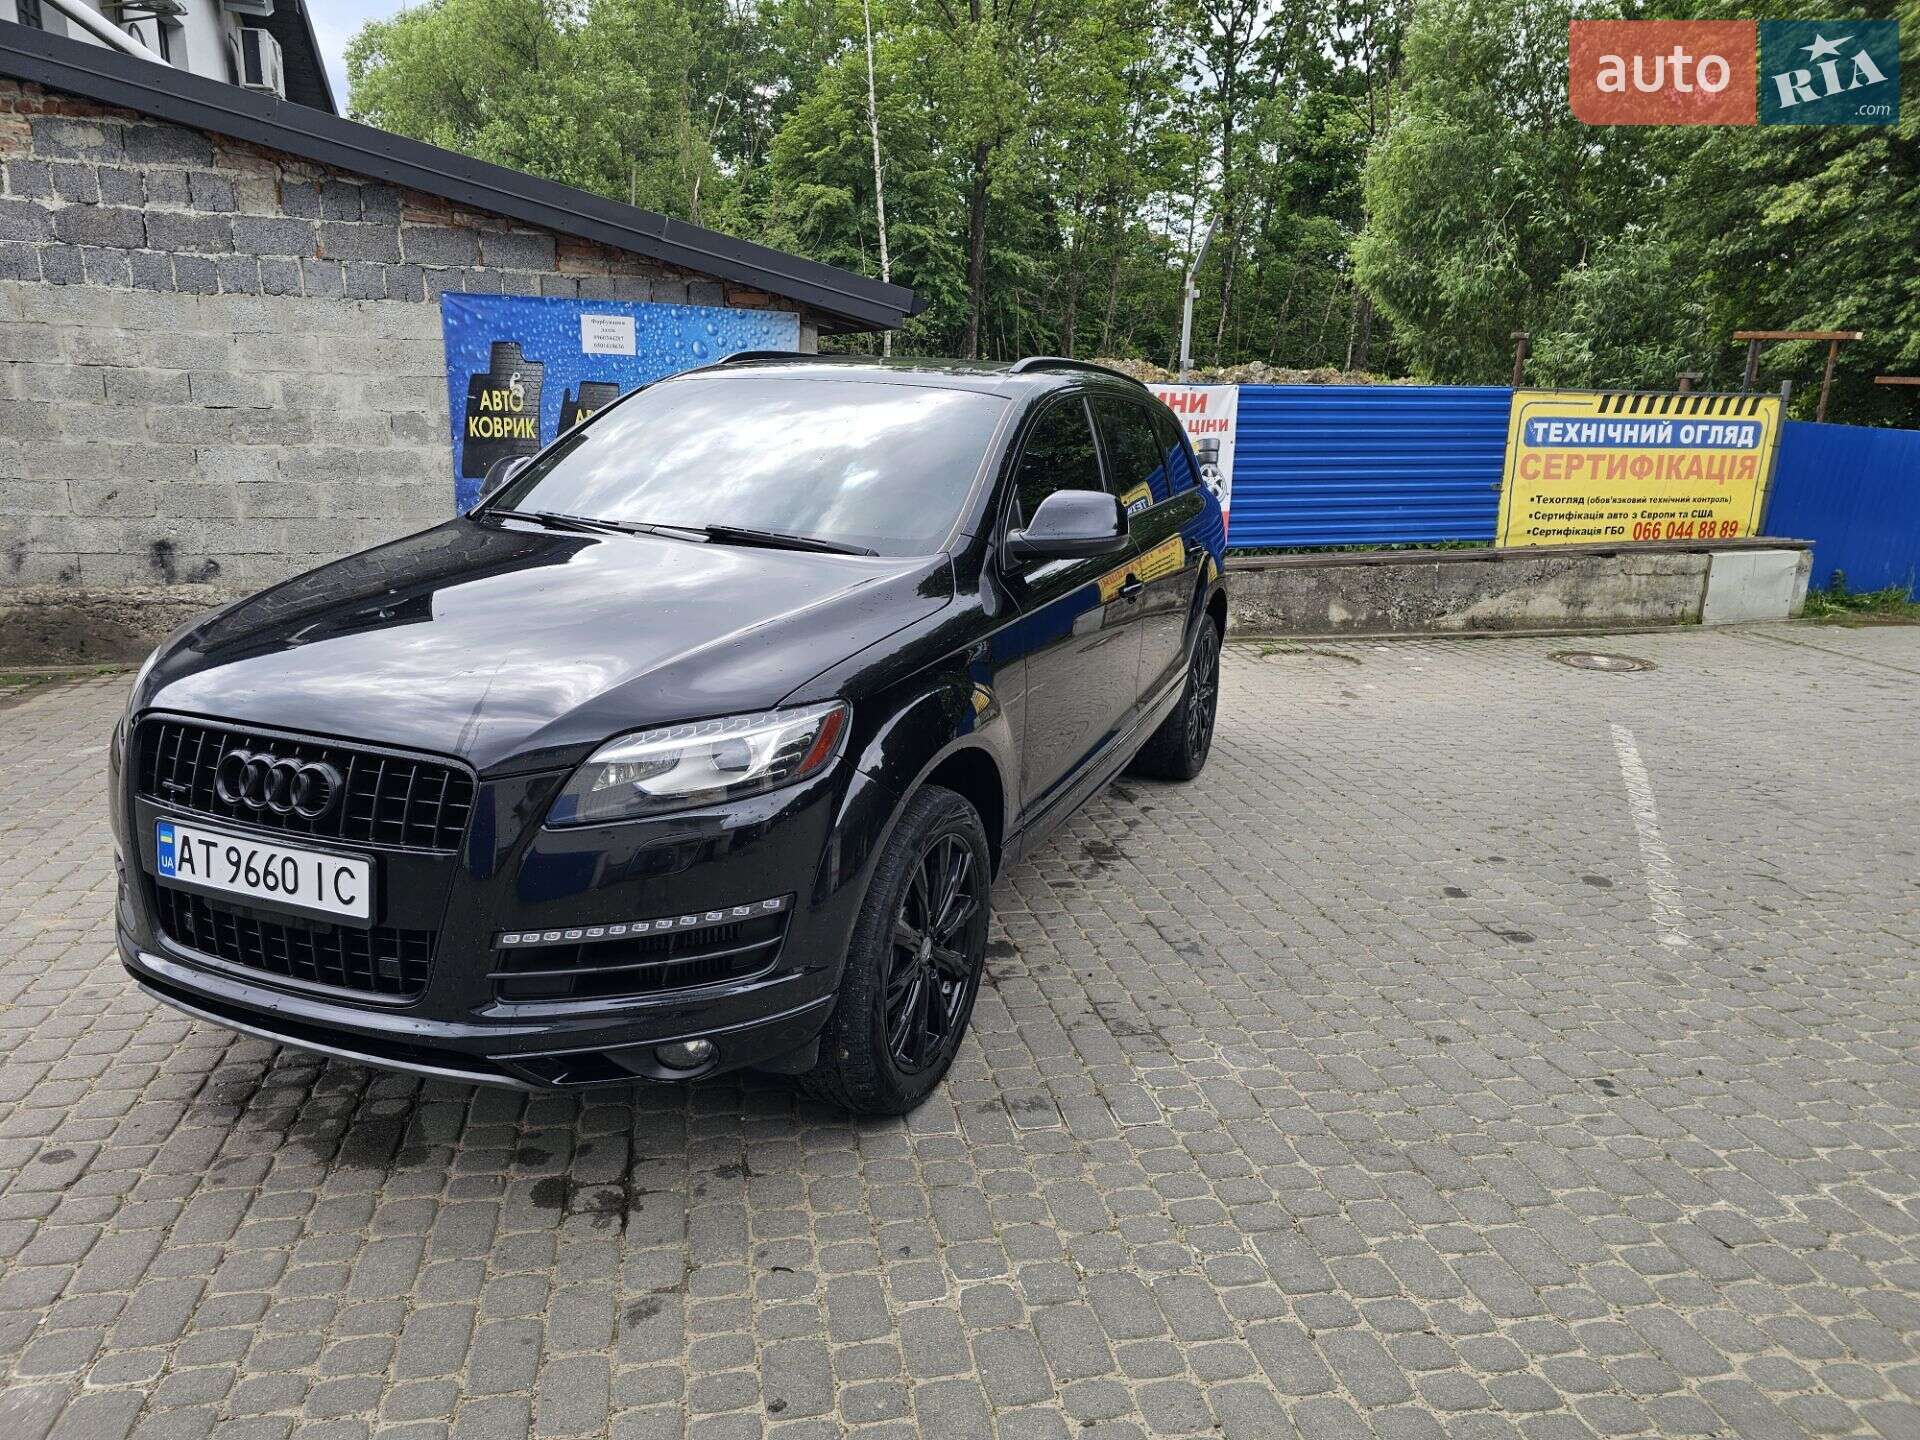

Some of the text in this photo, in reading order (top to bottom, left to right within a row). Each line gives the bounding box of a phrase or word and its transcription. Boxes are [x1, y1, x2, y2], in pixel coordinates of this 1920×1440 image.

[479, 388, 524, 412] АВТО
[468, 416, 537, 439] КОВРИК
[1187, 418, 1229, 435] ЦІНИ
[1533, 420, 1755, 448] ТЕХНІЧНИЙ ОГЛЯД
[1519, 453, 1759, 485] СЕРТИФІКАЦІЯ
[1536, 495, 1585, 505] Техогляд
[1649, 496, 1691, 504] технічний
[1533, 511, 1604, 521] Сертифікація
[1606, 512, 1629, 520] авто
[1640, 510, 1676, 520] Європи
[1691, 509, 1714, 519] США
[1531, 526, 1625, 538] Сертифікація ГБО
[1632, 520, 1739, 541] 066 044 88 89
[161, 855, 175, 870] UA
[177, 834, 357, 906] AT 9660 IC
